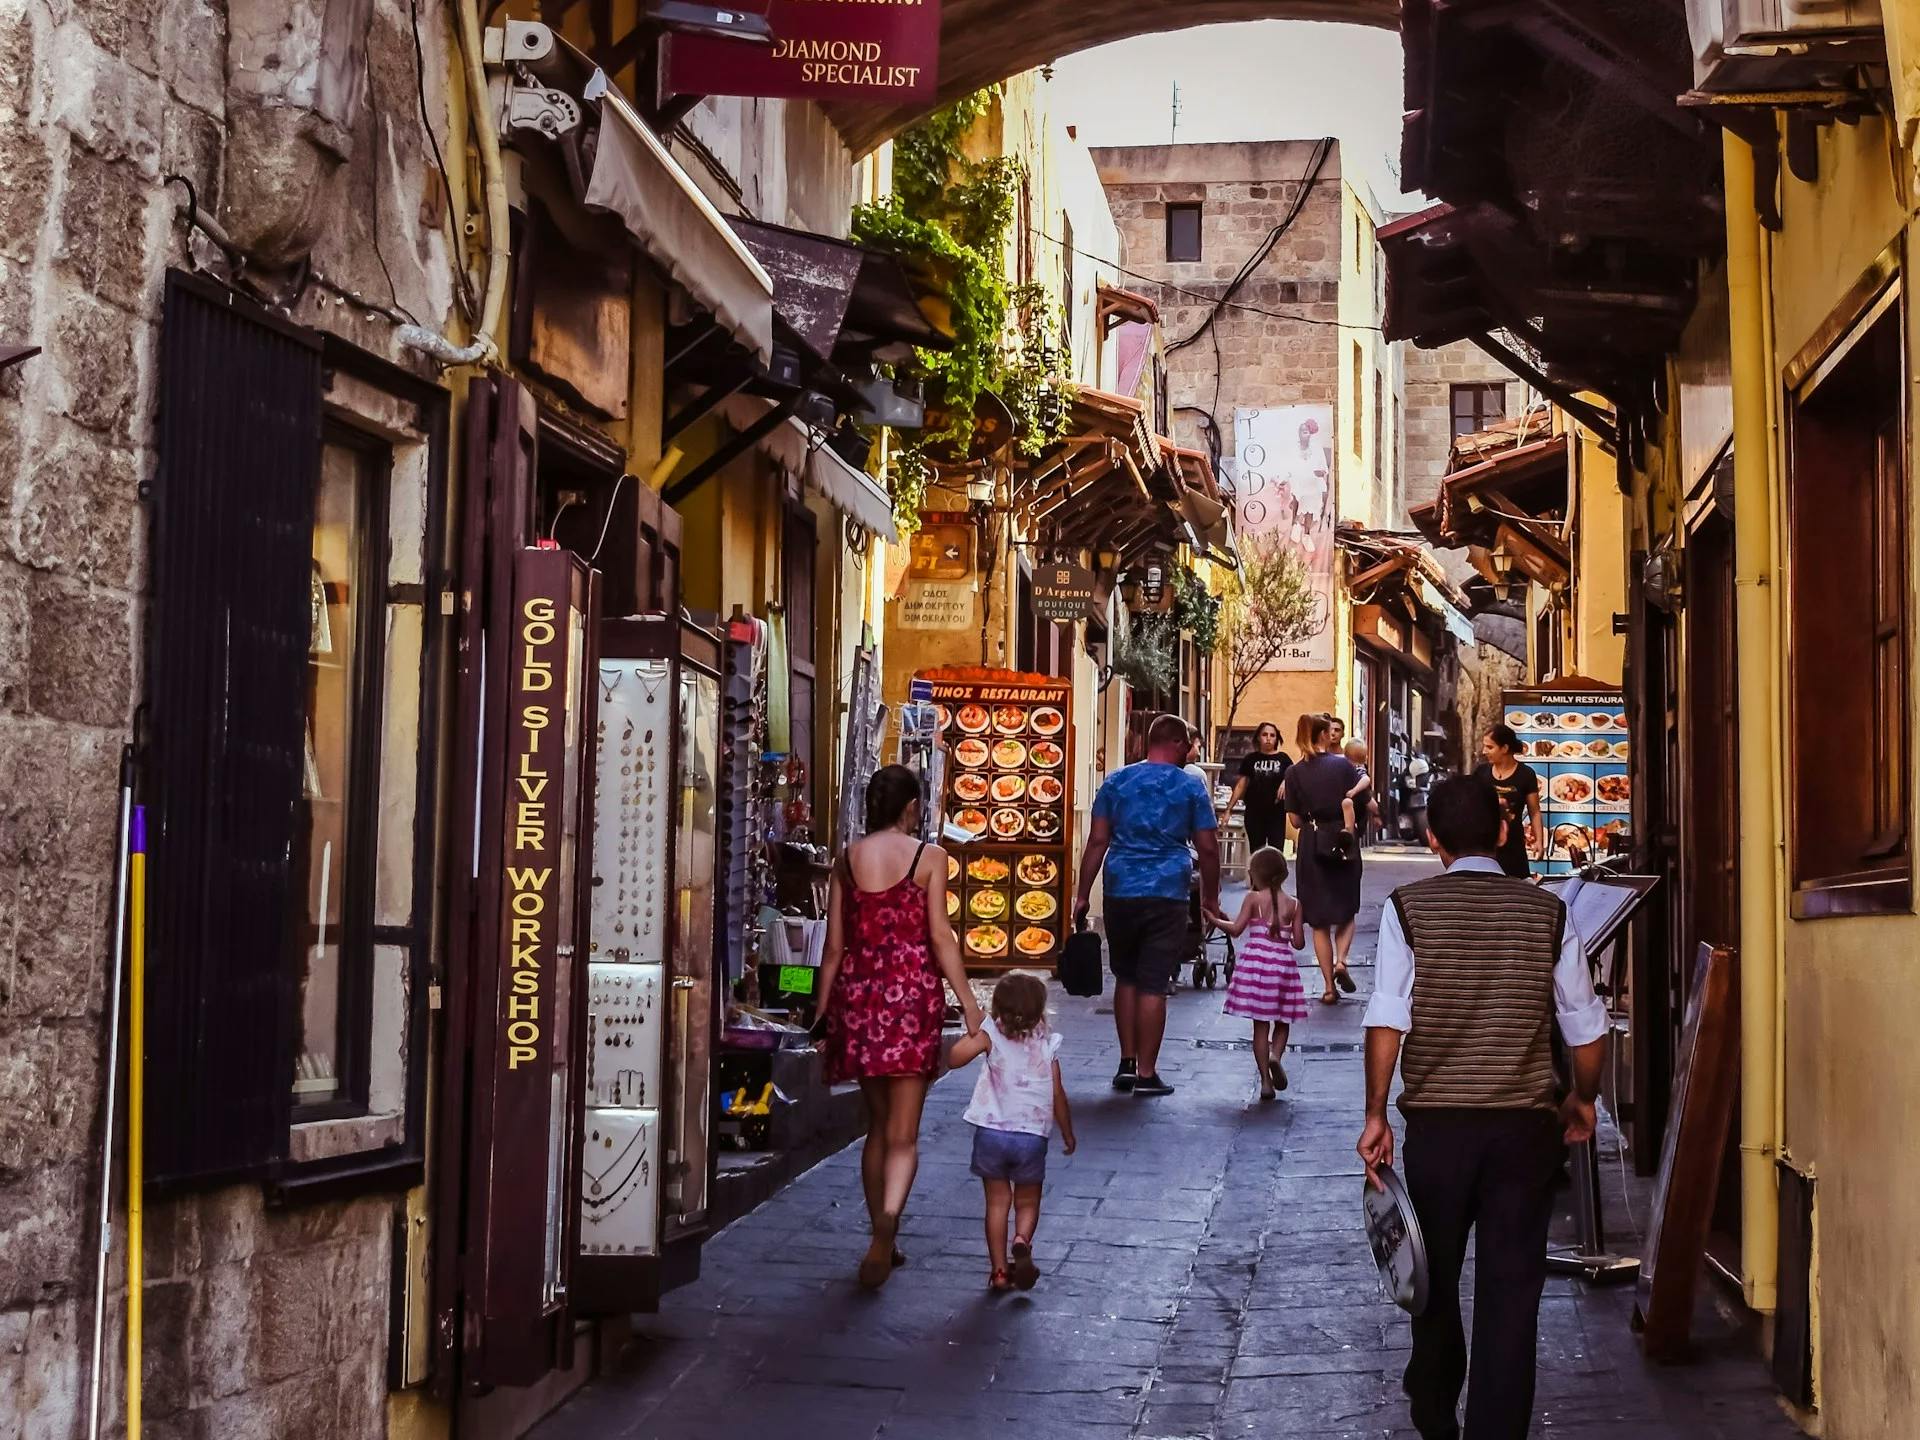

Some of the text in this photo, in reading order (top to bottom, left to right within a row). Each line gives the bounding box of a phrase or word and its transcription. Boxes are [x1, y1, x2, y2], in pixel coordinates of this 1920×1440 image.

[772, 39, 881, 62] DIAMOND
[802, 63, 920, 87] SPECIALIST
[922, 590, 948, 598] ΟΔΟΣ
[1035, 586, 1091, 599] D'Argento
[1037, 600, 1087, 609] BOUTIQUE
[1044, 610, 1079, 618] ROOMS
[980, 687, 1065, 701] RESTAURANT
[1541, 695, 1574, 704] FAMILY
[506, 598, 556, 1070] GOLD SILVER WORKSHOP
